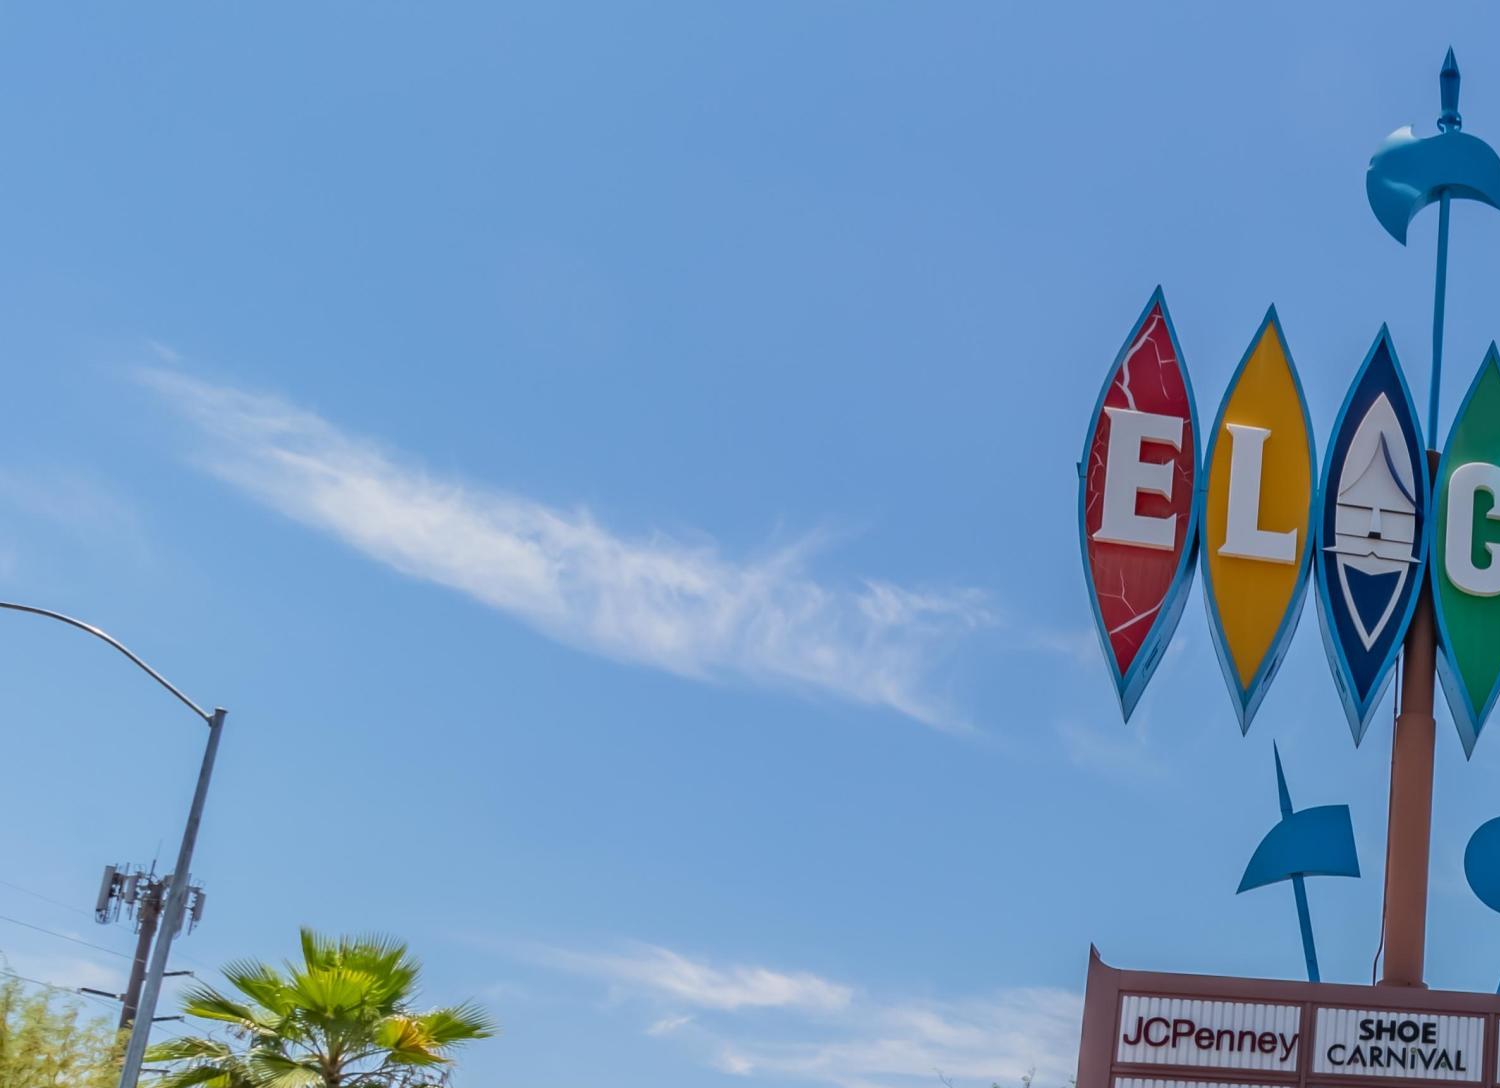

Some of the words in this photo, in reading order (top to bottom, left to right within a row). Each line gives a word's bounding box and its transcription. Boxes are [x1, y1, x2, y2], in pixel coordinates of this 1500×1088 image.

[1092, 405, 1298, 565] EL
[1122, 1016, 1300, 1062] JCPenney
[1359, 1019, 1437, 1044] SHOE
